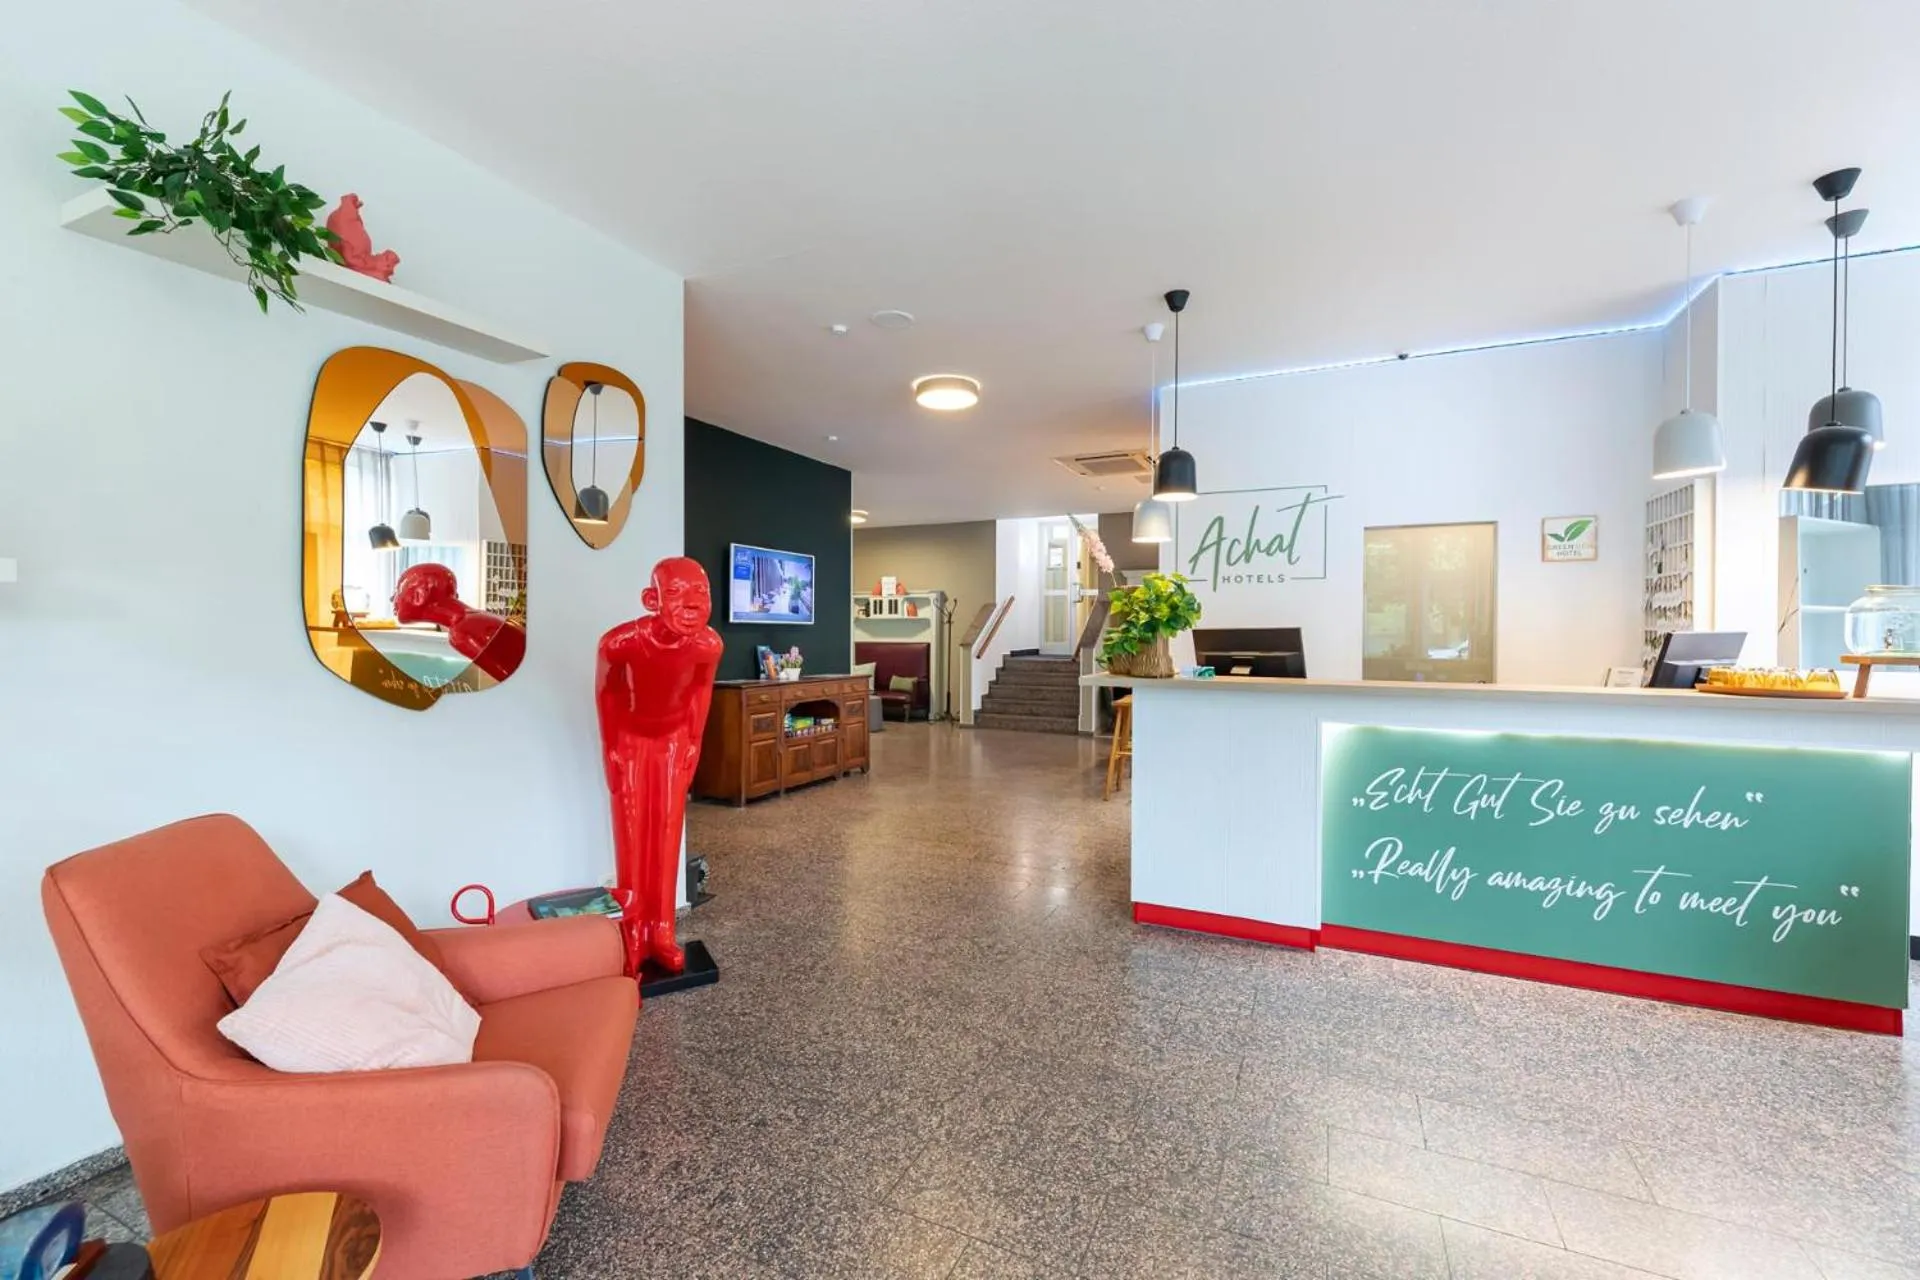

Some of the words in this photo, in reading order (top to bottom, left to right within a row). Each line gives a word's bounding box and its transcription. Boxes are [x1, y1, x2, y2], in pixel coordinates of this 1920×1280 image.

[1188, 492, 1346, 592] Achat
[1221, 574, 1286, 584] HOTELS
[1453, 772, 1546, 820] Gut
[1529, 779, 1585, 826] Sie
[1594, 802, 1640, 835] zu
[1487, 870, 1627, 922] amazing
[1632, 865, 1693, 914] to
[1679, 875, 1798, 927] meet
